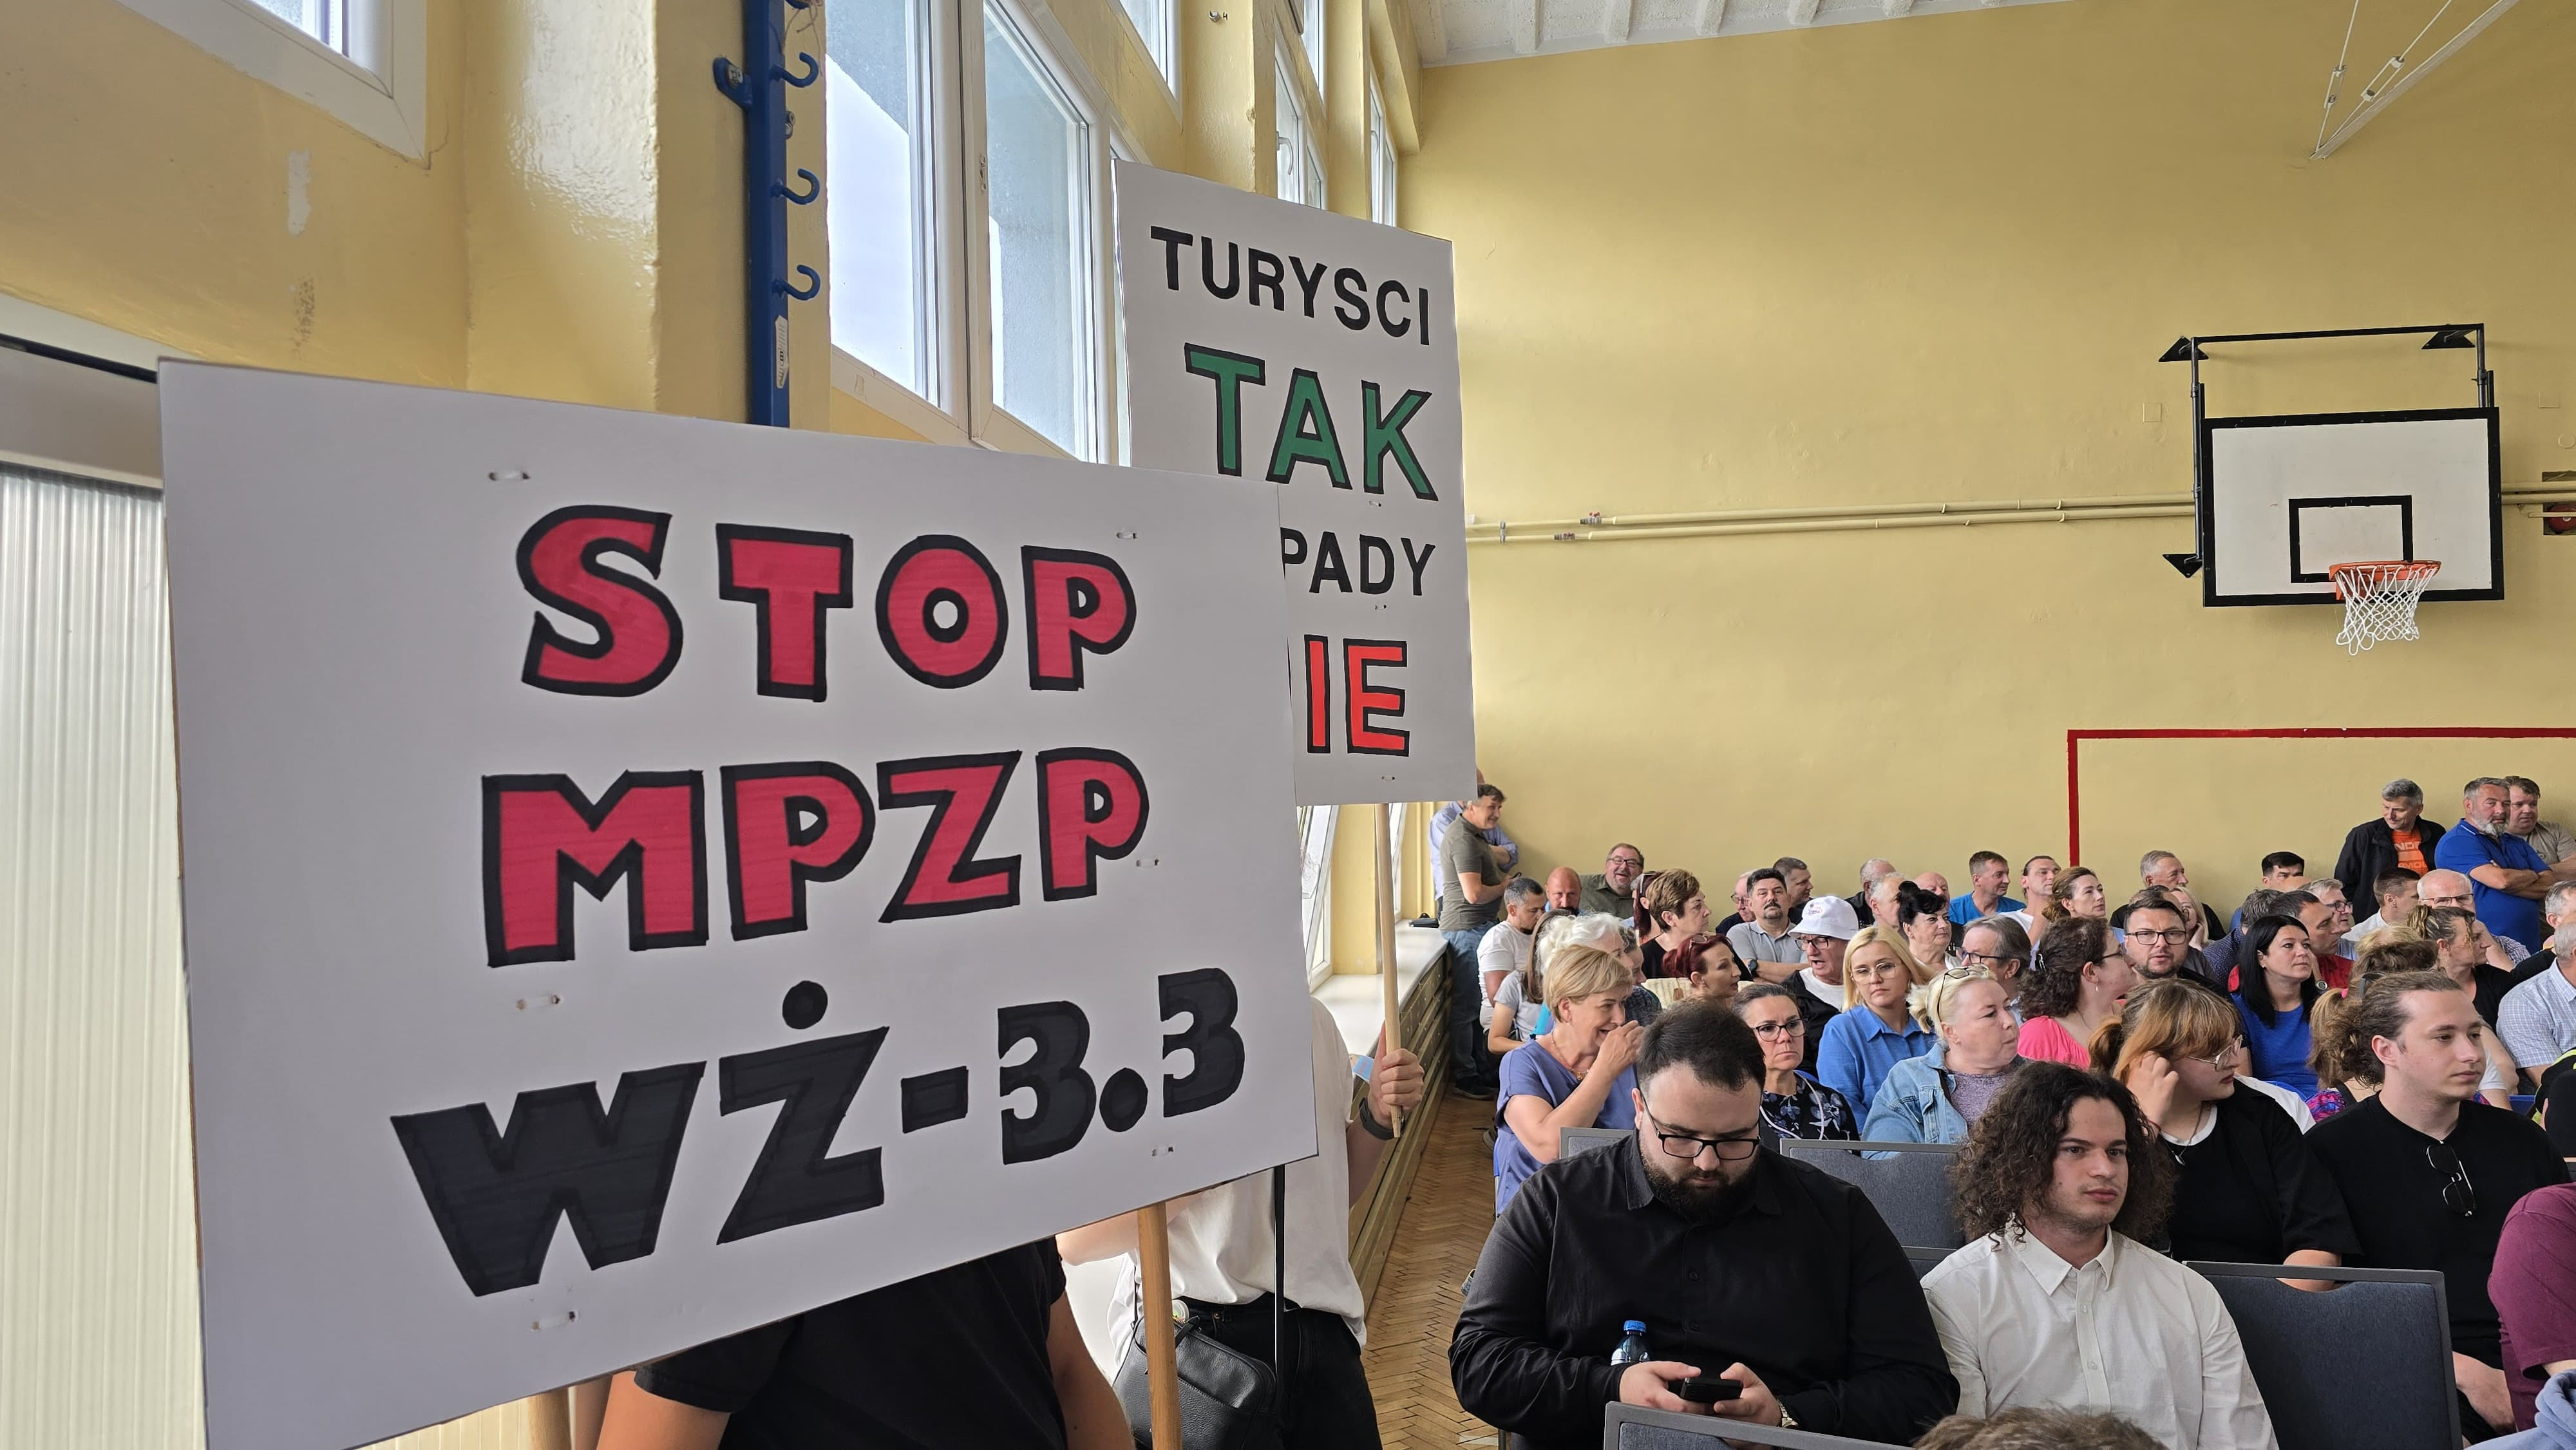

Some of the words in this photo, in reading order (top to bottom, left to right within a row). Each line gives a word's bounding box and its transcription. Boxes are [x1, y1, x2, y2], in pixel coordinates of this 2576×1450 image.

[1150, 225, 1430, 346] TURYSCI
[1184, 342, 1439, 502] TAK
[515, 504, 1137, 704] STOP
[1287, 634, 1410, 757] IE
[480, 746, 1150, 969] MPZP
[389, 966, 1246, 1298] WŻ-3.3
